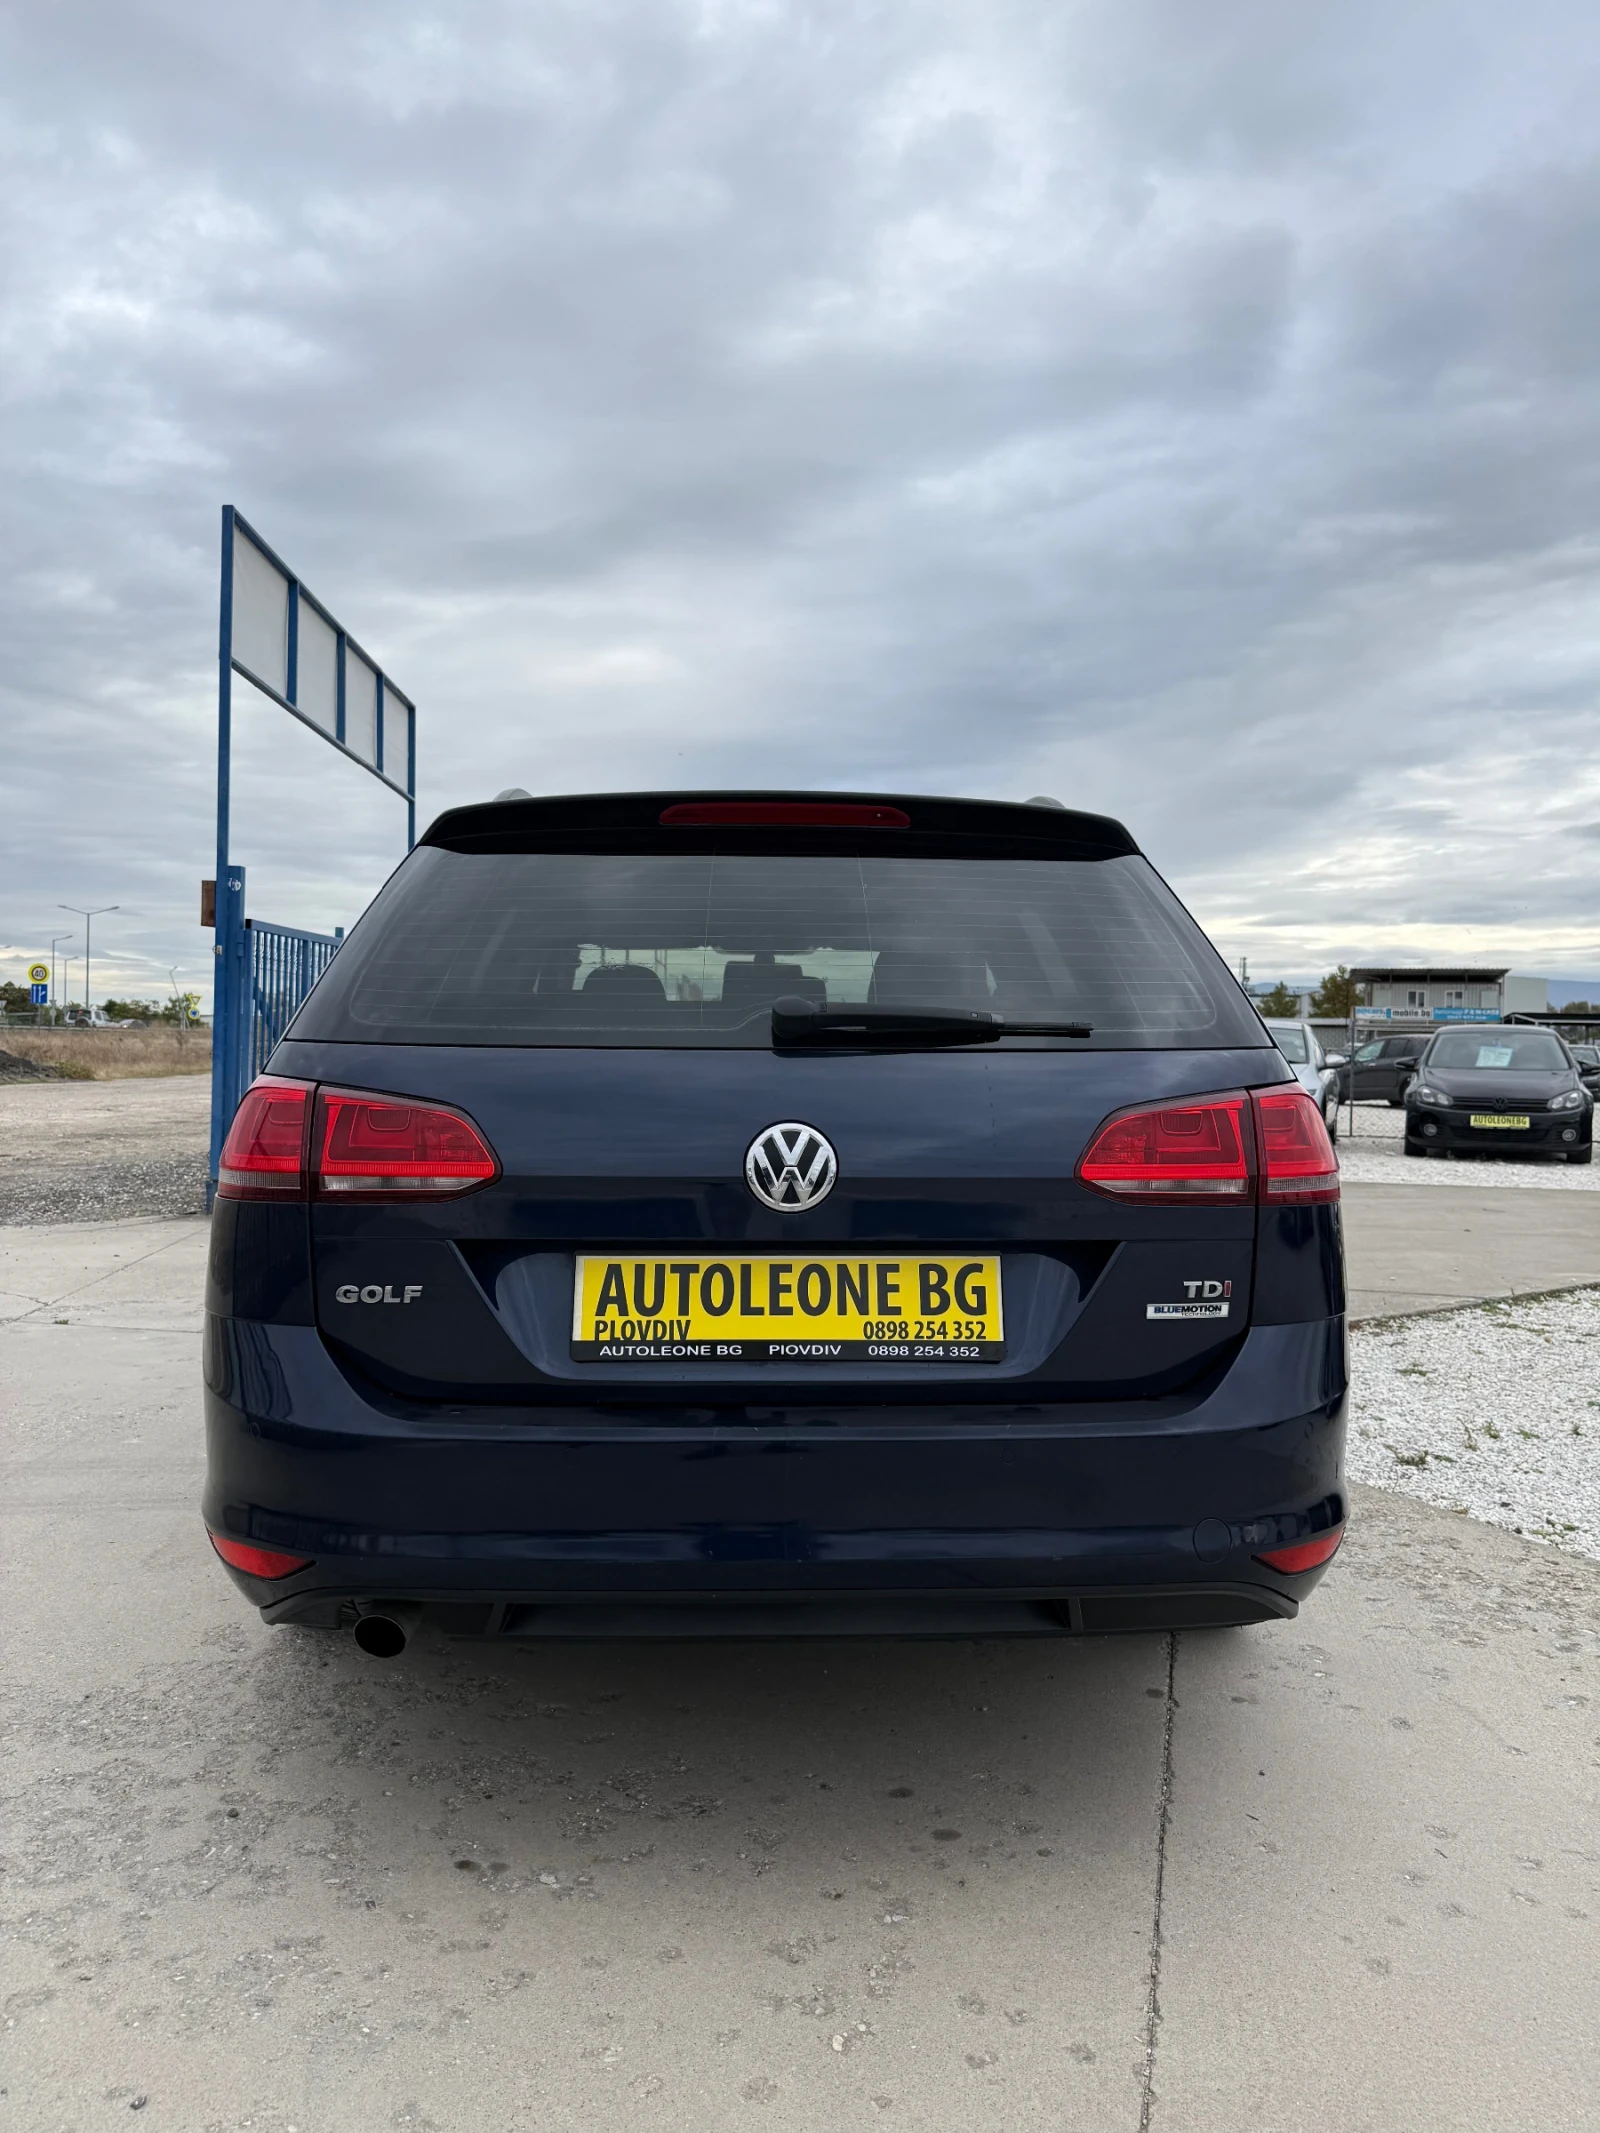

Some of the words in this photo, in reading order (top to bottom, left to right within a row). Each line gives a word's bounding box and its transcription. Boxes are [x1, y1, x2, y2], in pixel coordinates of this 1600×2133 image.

[34, 969, 44, 978] 40
[1392, 1009, 1431, 1018] mobile.bg
[1473, 1115, 1527, 1125] AUTOLEONEBG
[335, 1284, 423, 1304] GOLF
[594, 1262, 902, 1317] AUTOLEONE
[918, 1262, 988, 1317] BG
[1183, 1280, 1232, 1299] TDI
[1154, 1304, 1222, 1314] BLUEMOTION
[594, 1319, 692, 1341] PLOVDIV
[862, 1320, 908, 1340] 0898
[913, 1320, 948, 1340] 254
[952, 1320, 987, 1340] 352
[599, 1345, 711, 1357] AUTOLEONE
[716, 1345, 742, 1357] BG
[867, 1345, 909, 1356] 0898
[913, 1345, 945, 1357] 254
[948, 1346, 980, 1357] 352
